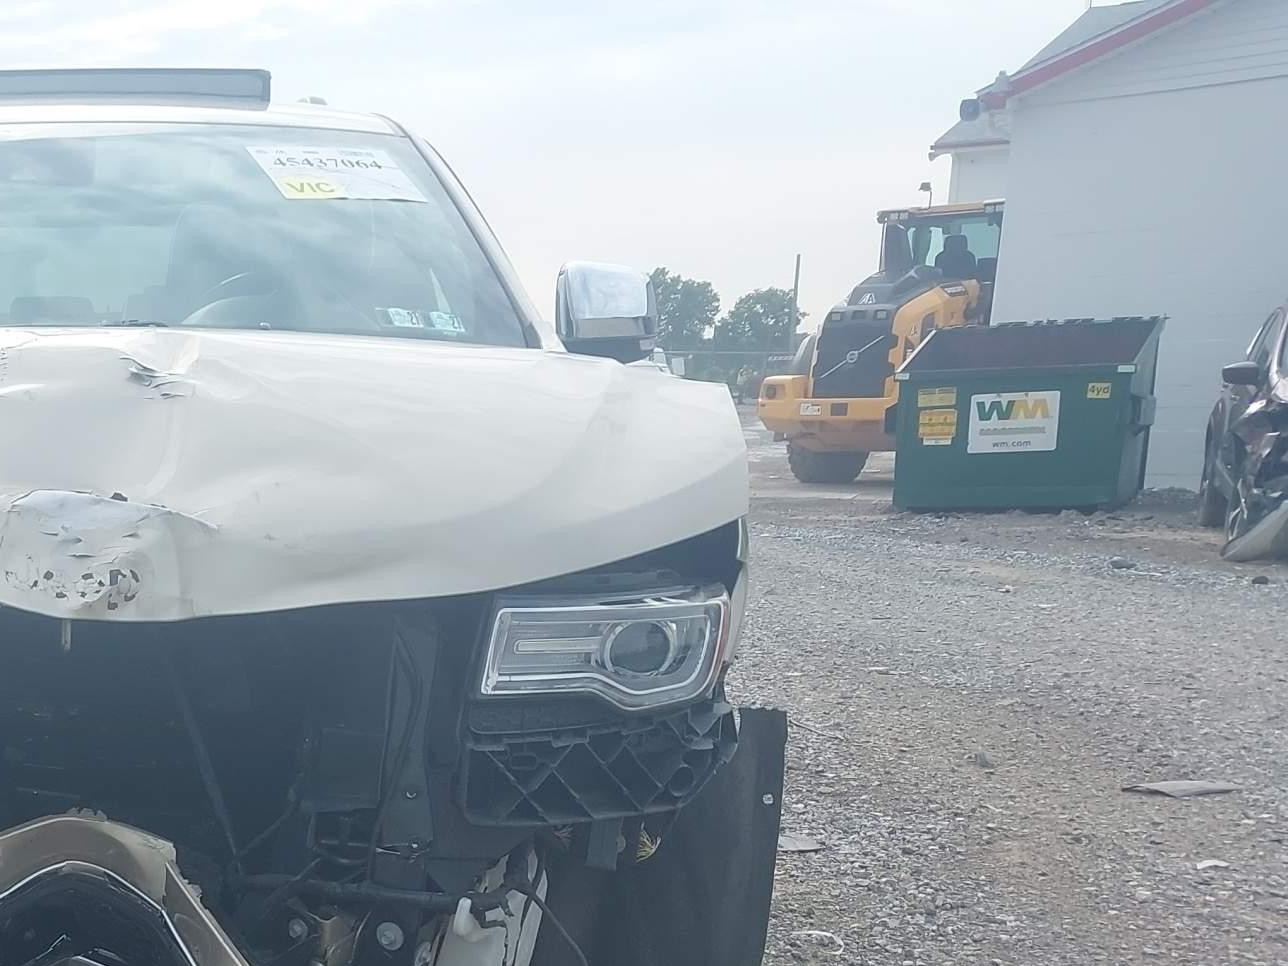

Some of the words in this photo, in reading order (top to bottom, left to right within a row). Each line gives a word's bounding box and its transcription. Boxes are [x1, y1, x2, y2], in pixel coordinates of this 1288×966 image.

[273, 156, 383, 170] 45437064
[285, 182, 335, 193] VIC
[975, 398, 1049, 421] WM
[991, 439, 1032, 448] wm.com
